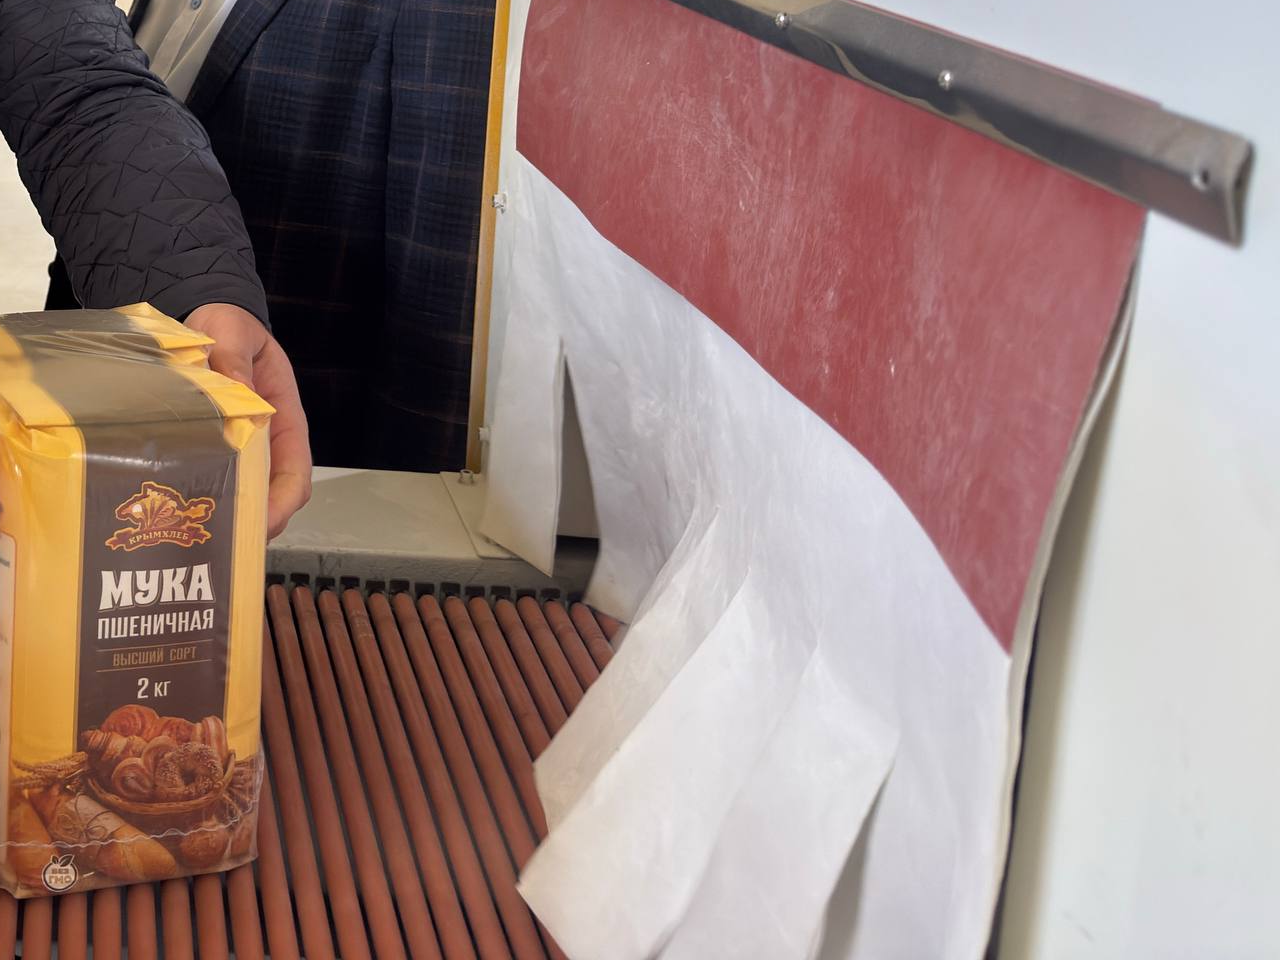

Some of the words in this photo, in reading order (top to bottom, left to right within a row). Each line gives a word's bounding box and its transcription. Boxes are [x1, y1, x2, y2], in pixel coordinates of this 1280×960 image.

[128, 529, 190, 545] КРЫМХЛЕБ
[98, 563, 215, 611] МУКА
[97, 608, 214, 640] ПШЕНИЧНАЯ
[113, 648, 164, 667] ВЫСШИЙ
[169, 646, 197, 662] СОРТ
[137, 677, 149, 699] 2
